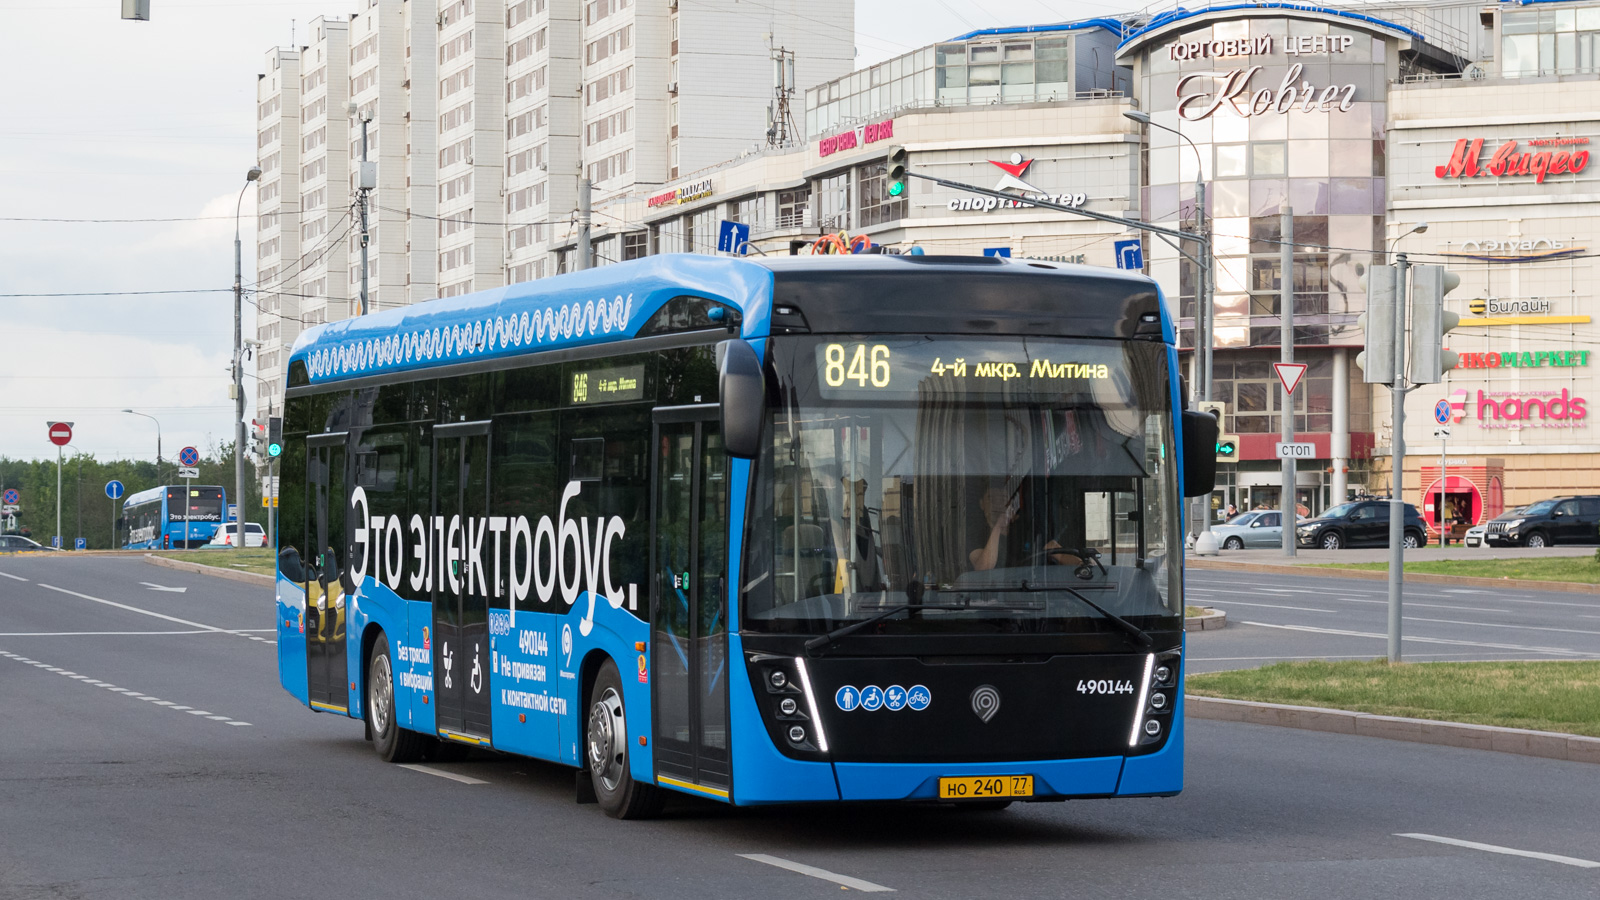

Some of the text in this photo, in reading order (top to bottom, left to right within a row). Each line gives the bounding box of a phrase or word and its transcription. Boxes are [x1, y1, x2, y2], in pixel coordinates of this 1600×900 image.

[1165, 33, 1354, 60] ТОРГОВЫЙ ЦЕНТР
[1528, 137, 1589, 148] электроника
[1435, 138, 1590, 183] М.видео
[1488, 297, 1550, 314] Билайн
[825, 344, 1109, 387] 846 4-й мкр. Митина
[1442, 348, 1591, 369] ЛКОМАРКЕТ
[573, 373, 588, 402] 846
[1477, 388, 1587, 421] hands
[1282, 445, 1310, 456] СТОП
[183, 513, 221, 521] эектробус.
[77, 539, 84, 548] P
[350, 480, 638, 637] Это электробус.
[397, 640, 430, 667] Без тряски
[519, 629, 548, 657] 490144
[403, 667, 433, 693] вибраций
[501, 654, 511, 678] Не
[512, 661, 547, 684] привязан
[1076, 679, 1134, 694] 490144
[501, 688, 567, 716] к контактной сети
[974, 779, 1003, 795] 240
[1012, 778, 1028, 789] 77
